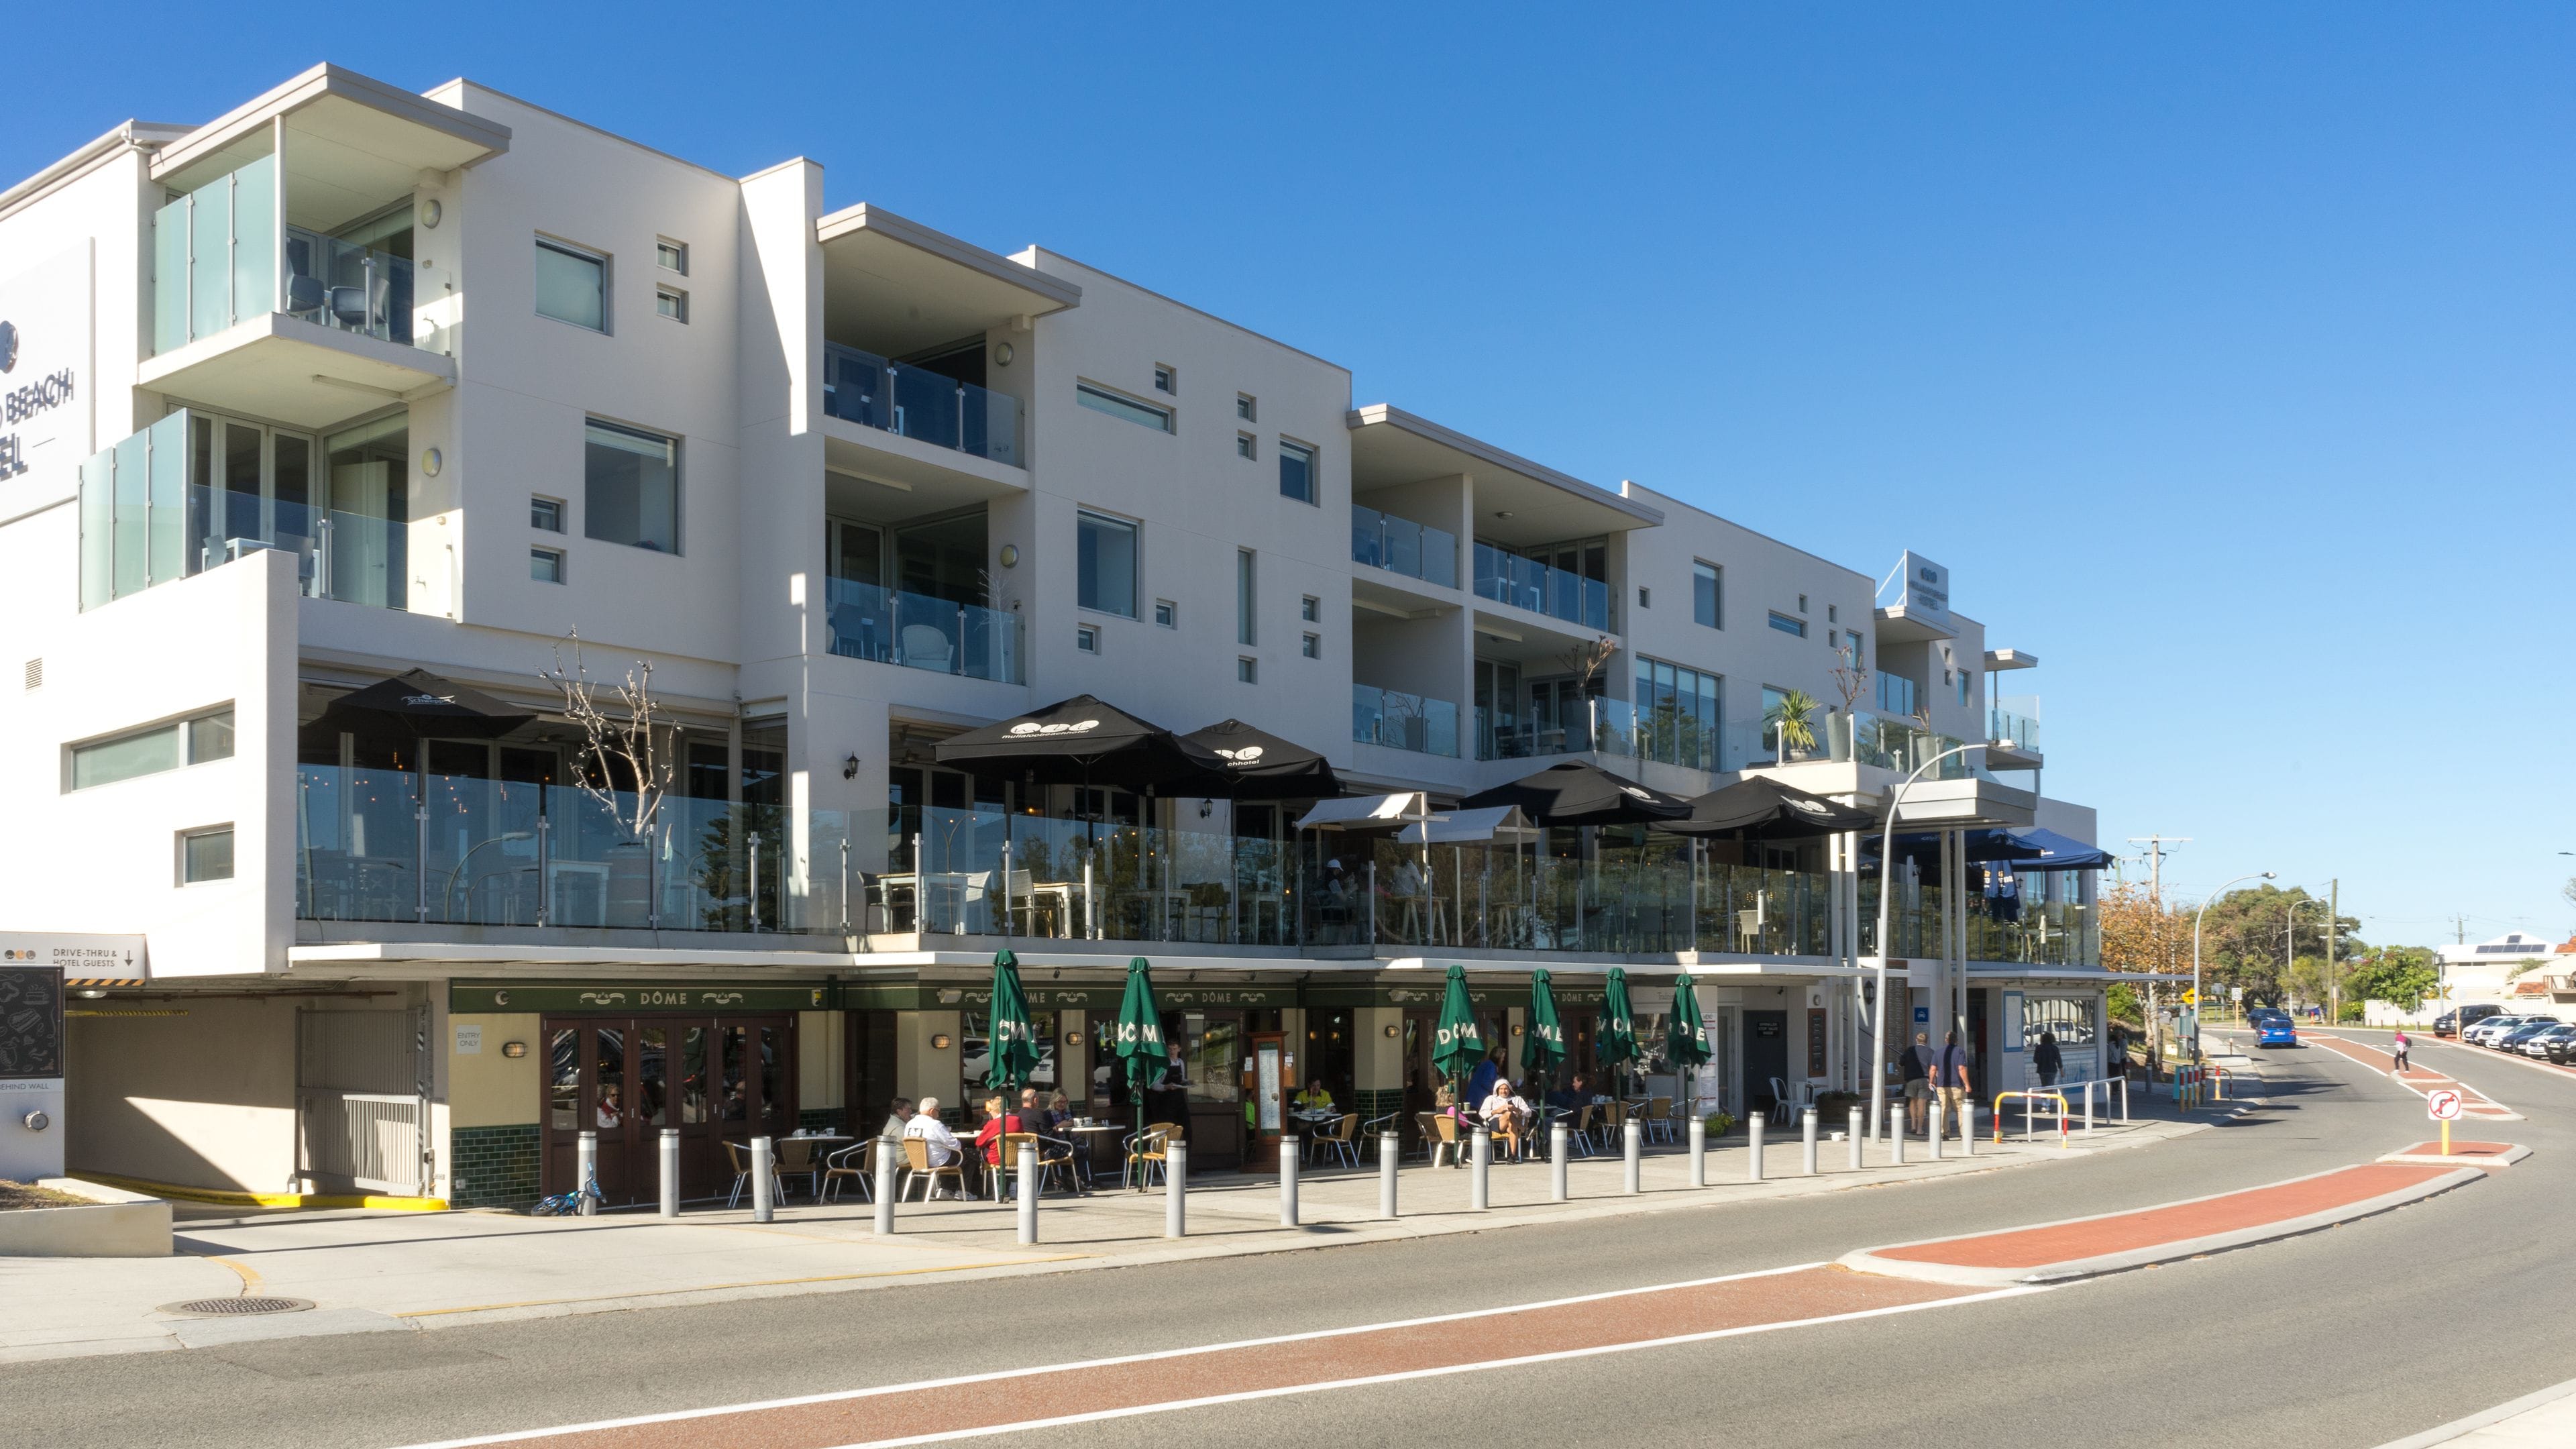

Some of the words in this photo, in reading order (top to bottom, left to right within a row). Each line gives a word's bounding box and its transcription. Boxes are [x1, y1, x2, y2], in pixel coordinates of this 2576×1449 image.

[6, 368, 70, 423] BEACH
[53, 949, 109, 957] DRIVE-THRU
[640, 991, 687, 1004] DÔME
[1202, 991, 1231, 1003] DÔME
